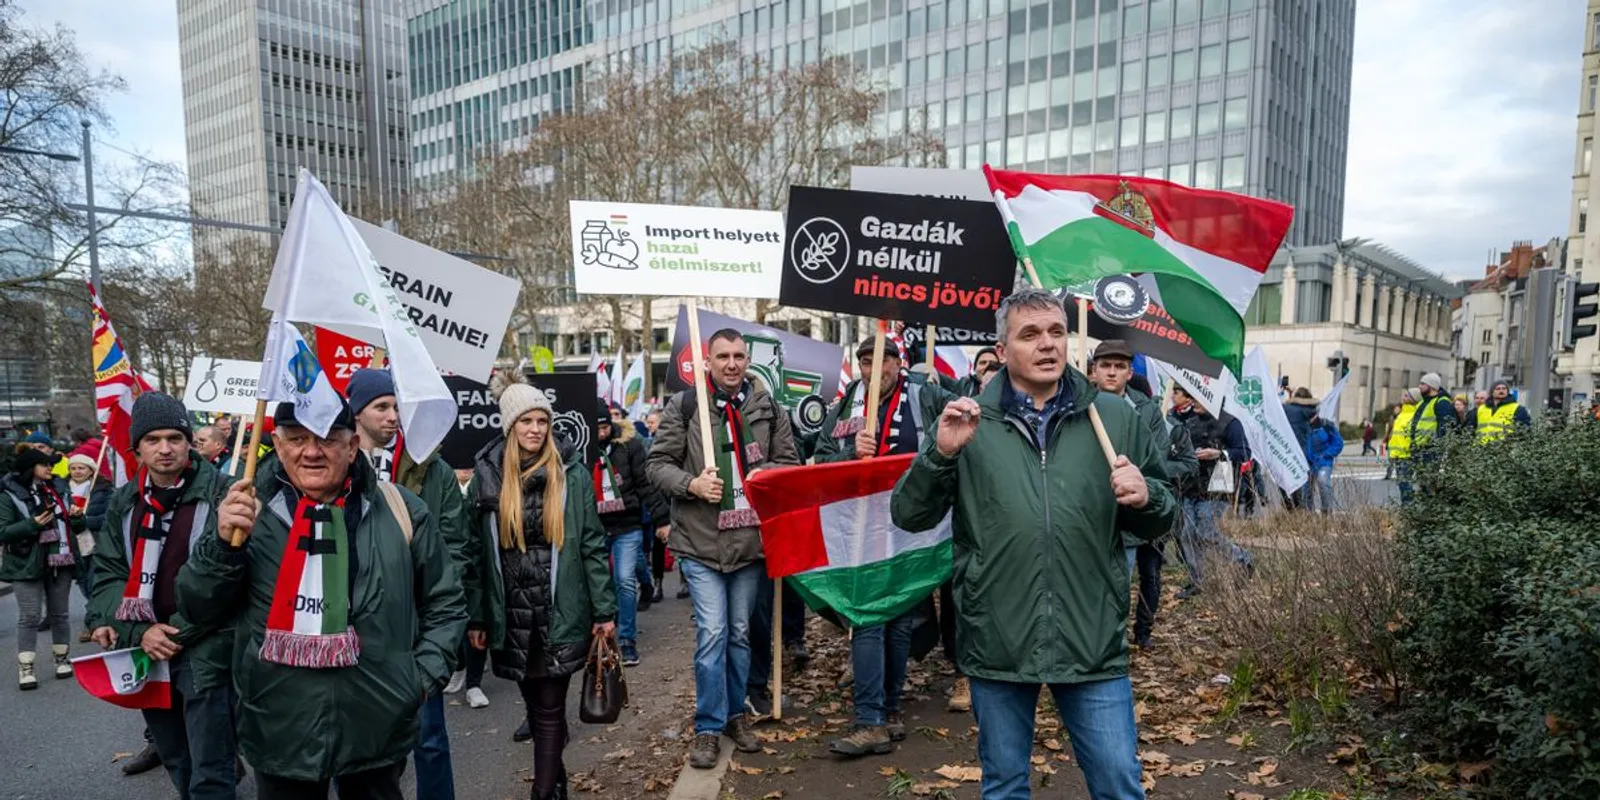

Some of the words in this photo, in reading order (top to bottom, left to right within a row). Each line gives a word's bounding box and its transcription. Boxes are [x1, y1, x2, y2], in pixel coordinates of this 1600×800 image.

[645, 225, 710, 241] Import
[714, 226, 780, 244] helyett
[860, 216, 965, 246] Gazdák
[647, 240, 699, 254] hazai
[649, 256, 763, 274] élelmiszert!
[857, 247, 942, 275] nélkül
[853, 275, 927, 303] nincs
[929, 281, 1001, 310] jövő!
[402, 303, 489, 349] RAINE!
[335, 346, 348, 359] A
[351, 346, 375, 359] GR
[226, 377, 258, 387] GREE
[223, 387, 235, 396] IS
